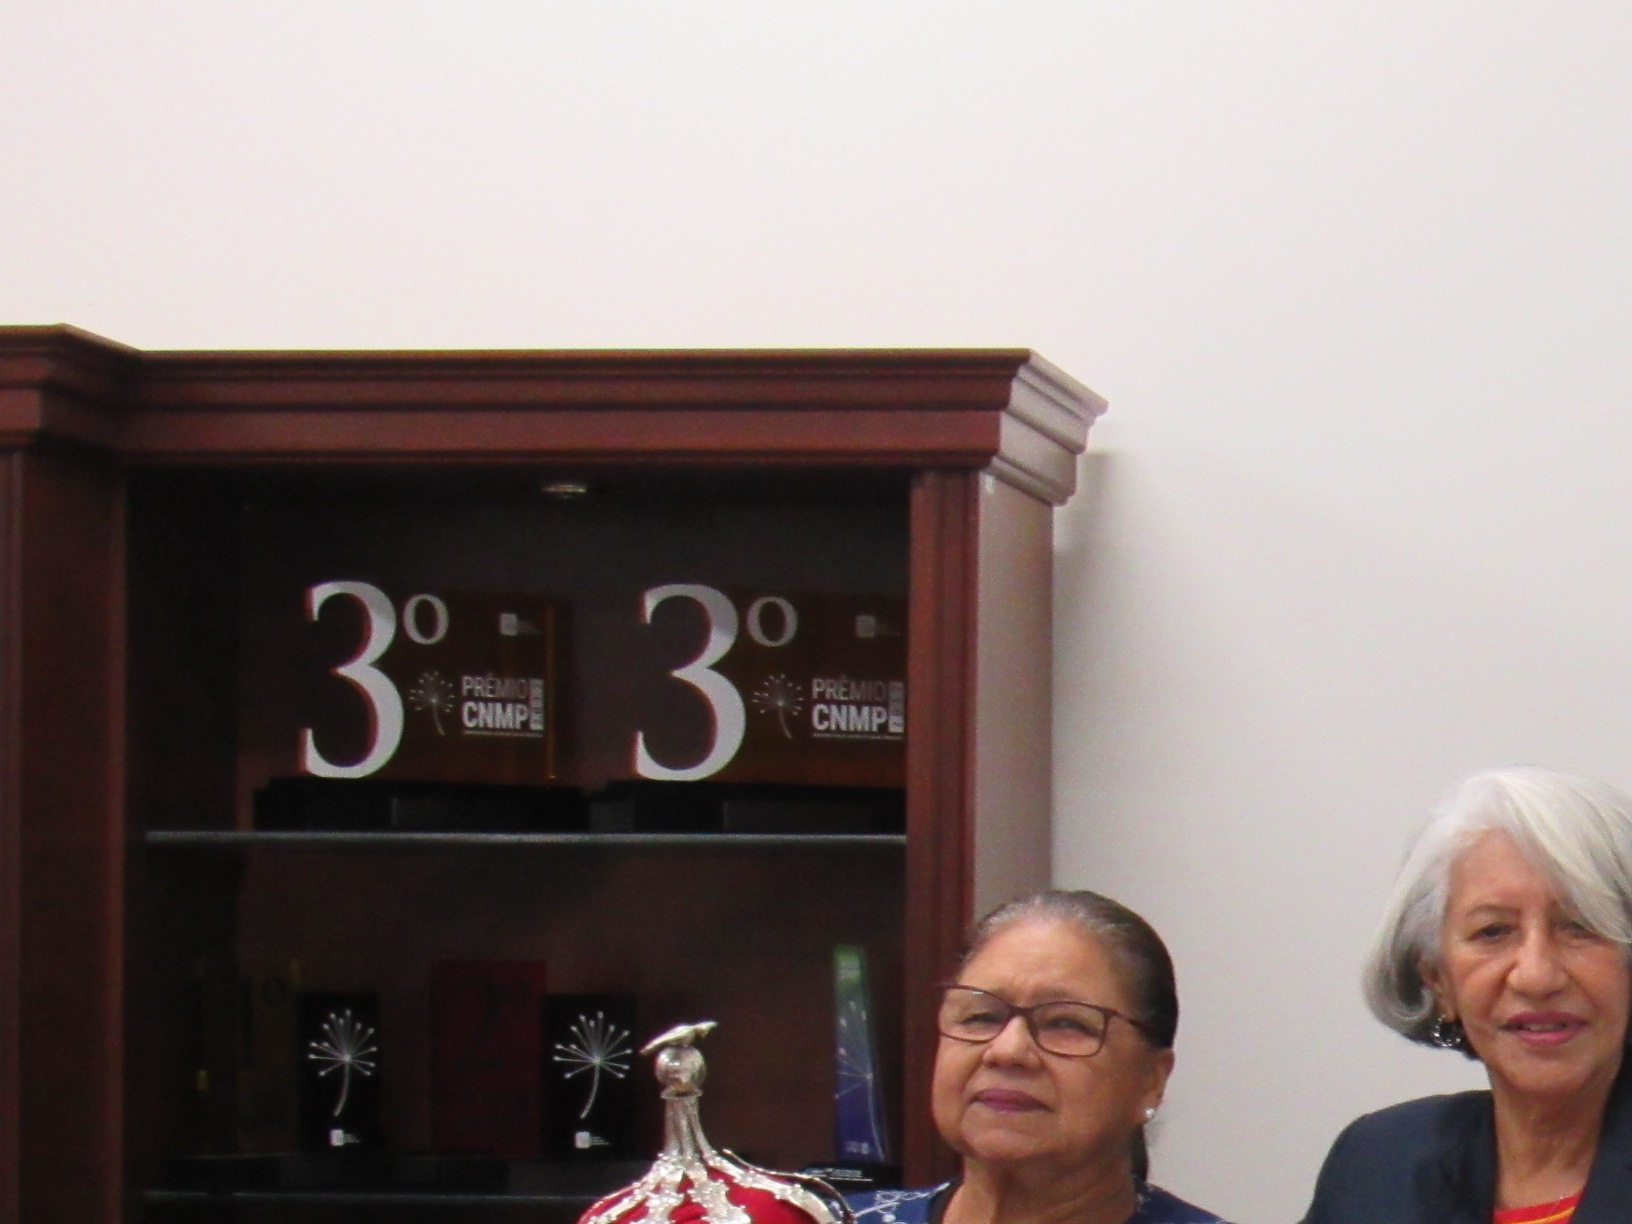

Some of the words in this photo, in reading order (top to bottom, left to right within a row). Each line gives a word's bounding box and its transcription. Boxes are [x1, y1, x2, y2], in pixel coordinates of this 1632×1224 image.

[811, 674, 887, 702] PRÊMIO
[461, 701, 529, 730] CNMP
[811, 703, 887, 732] CNMP
